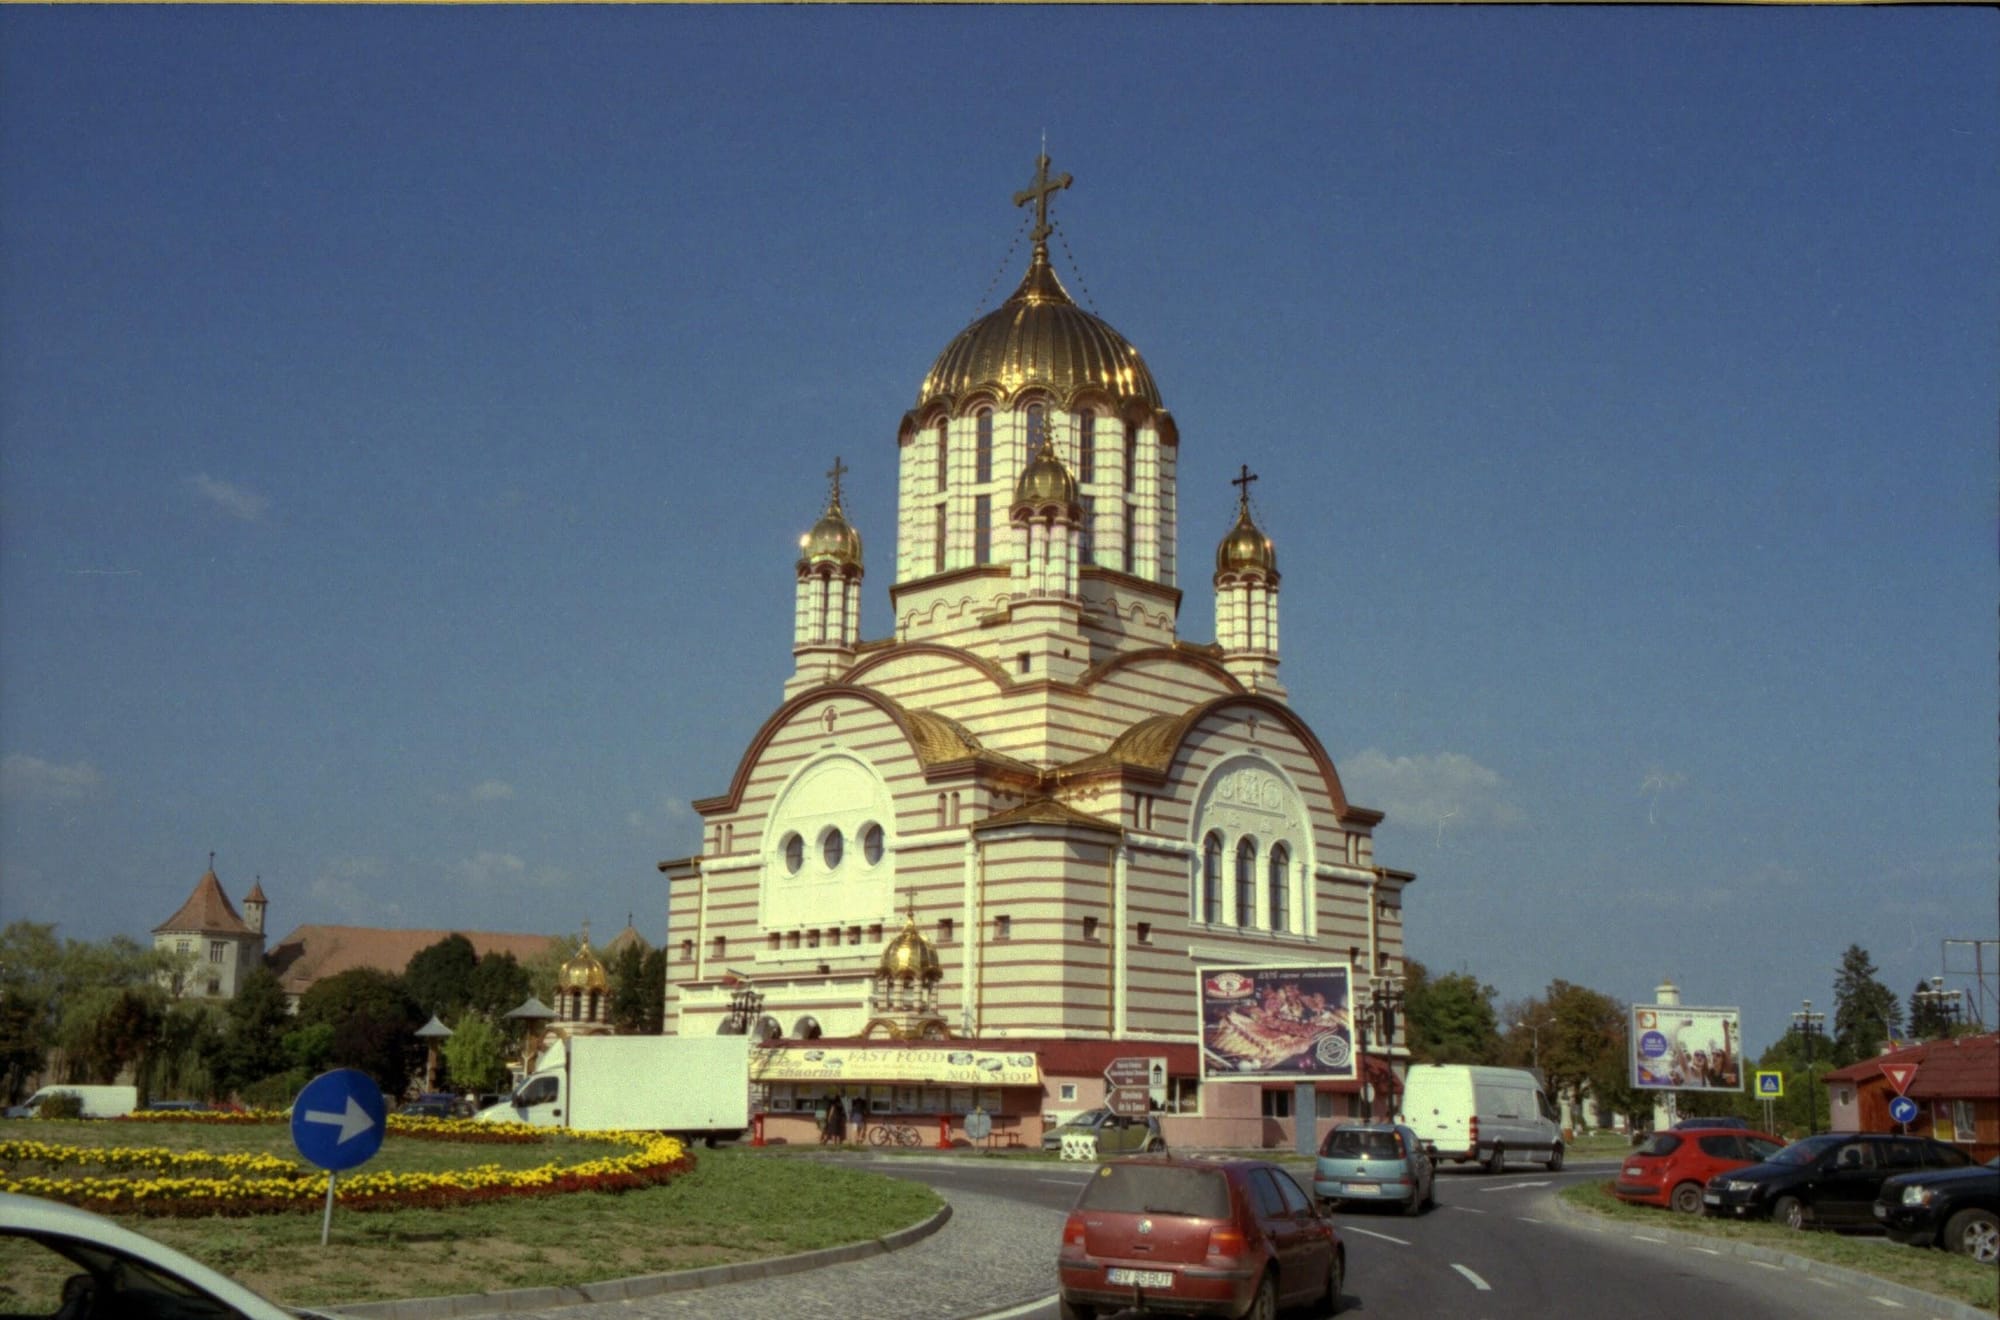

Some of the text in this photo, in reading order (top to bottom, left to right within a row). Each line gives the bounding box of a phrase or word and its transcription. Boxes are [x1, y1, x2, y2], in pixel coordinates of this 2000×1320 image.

[847, 1050, 946, 1063] FAST FOOD
[777, 1067, 842, 1078] shaorma
[947, 1069, 981, 1081] NON
[990, 1071, 1033, 1082] STOP
[1114, 1270, 1129, 1281] BV
